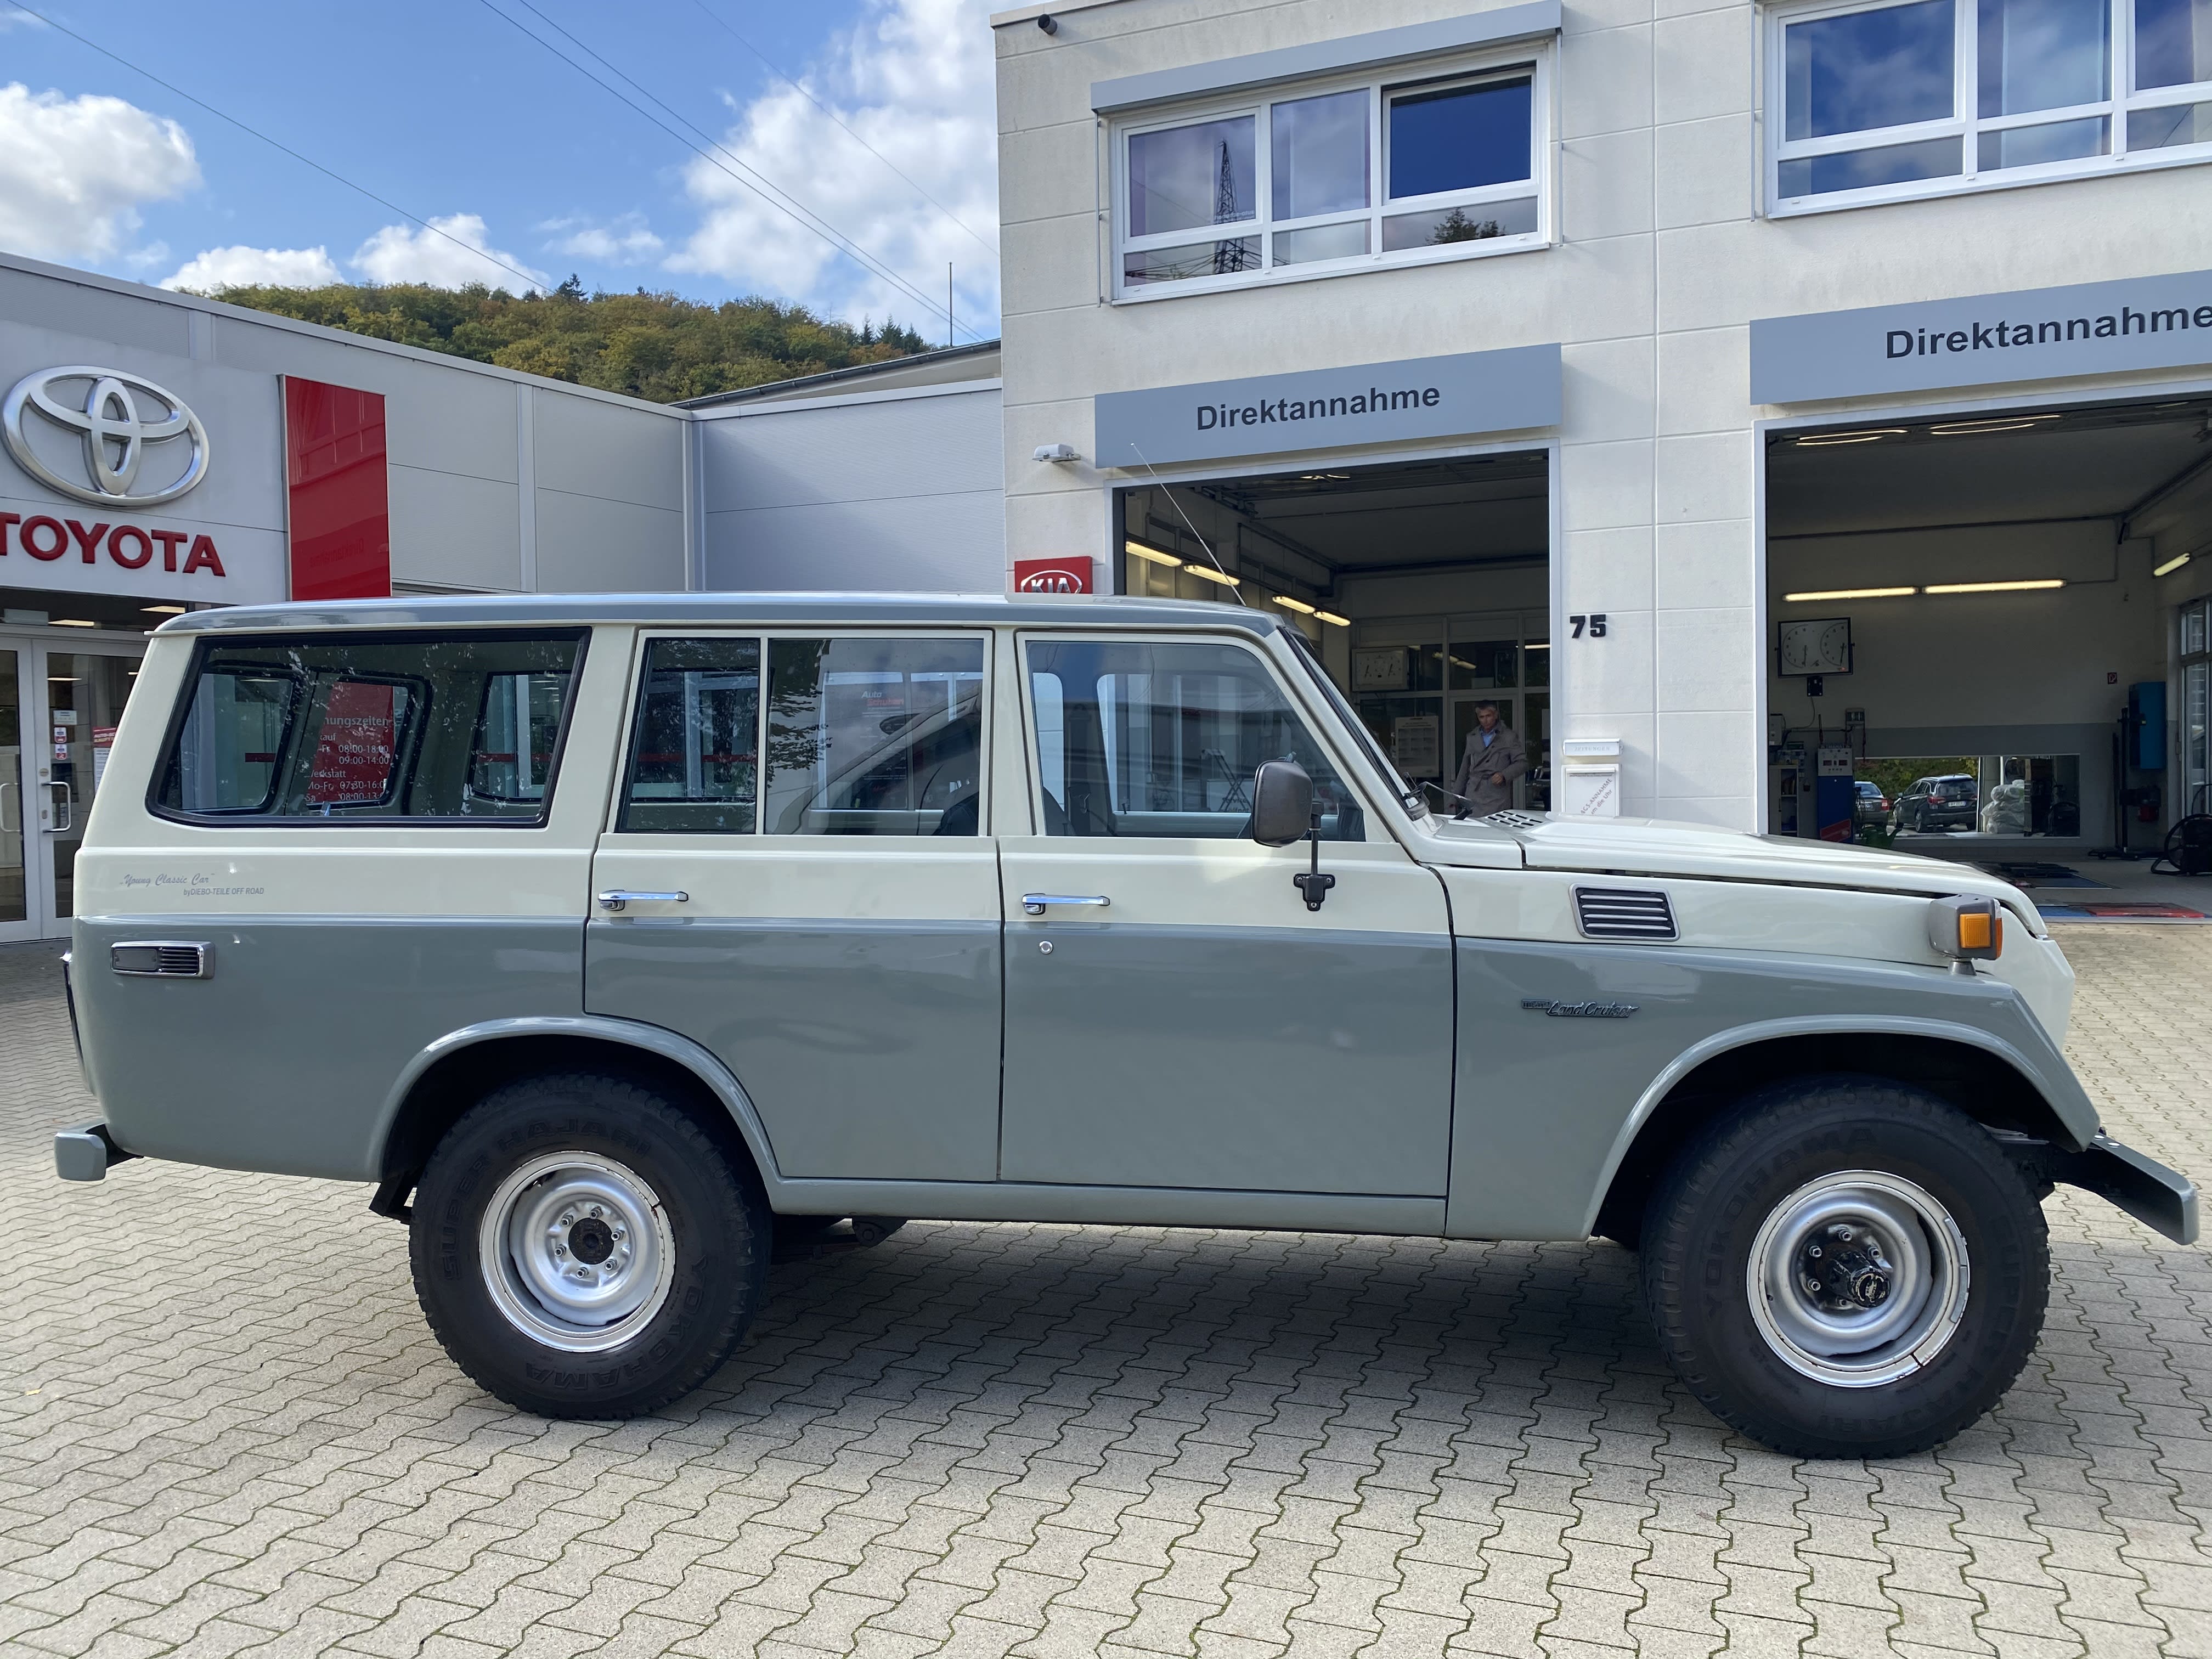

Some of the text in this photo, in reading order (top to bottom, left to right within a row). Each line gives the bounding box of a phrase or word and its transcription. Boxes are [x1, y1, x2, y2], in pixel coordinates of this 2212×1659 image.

[1886, 306, 2212, 359] Direktannahme
[1197, 387, 1441, 431] Direktannahme
[0, 512, 226, 577] TOYOTA
[1031, 577, 1071, 594] KIA
[1569, 614, 1607, 639] 75
[339, 756, 389, 765] 09:00-14:00
[1603, 789, 1612, 799] Uhr
[155, 873, 187, 885] Classic
[1547, 1000, 1584, 1015] Land
[1584, 1001, 1640, 1018] Cruiser
[1705, 1127, 1877, 1316] YOKOHAMA
[525, 1254, 709, 1391] YOKOHAMA
